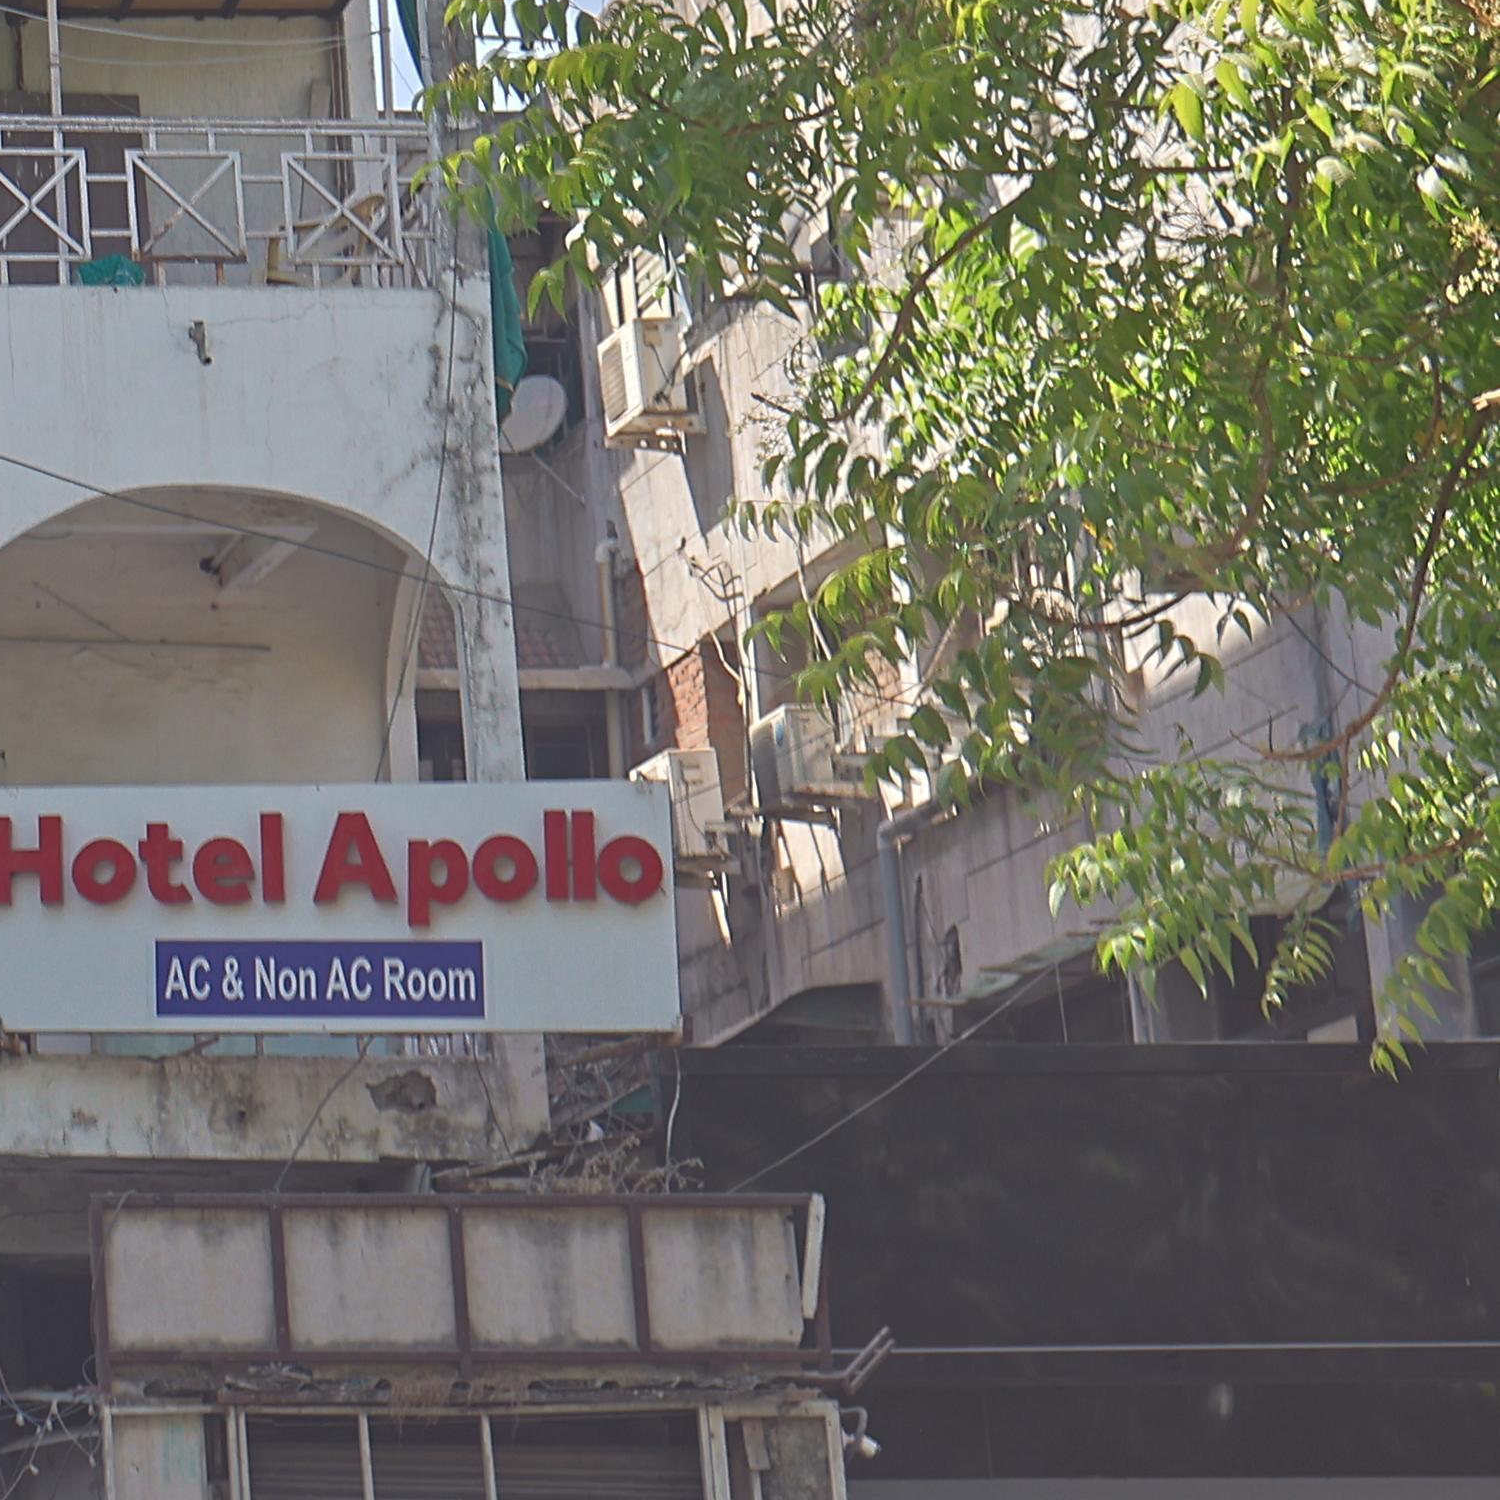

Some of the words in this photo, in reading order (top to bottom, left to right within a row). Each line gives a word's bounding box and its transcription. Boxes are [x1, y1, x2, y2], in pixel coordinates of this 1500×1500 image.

[313, 808, 665, 928] Apollo
[164, 955, 211, 1001] AC
[222, 956, 246, 1001] &
[254, 956, 318, 1001] Non
[325, 956, 374, 1001] AC
[384, 956, 477, 1002] Room
